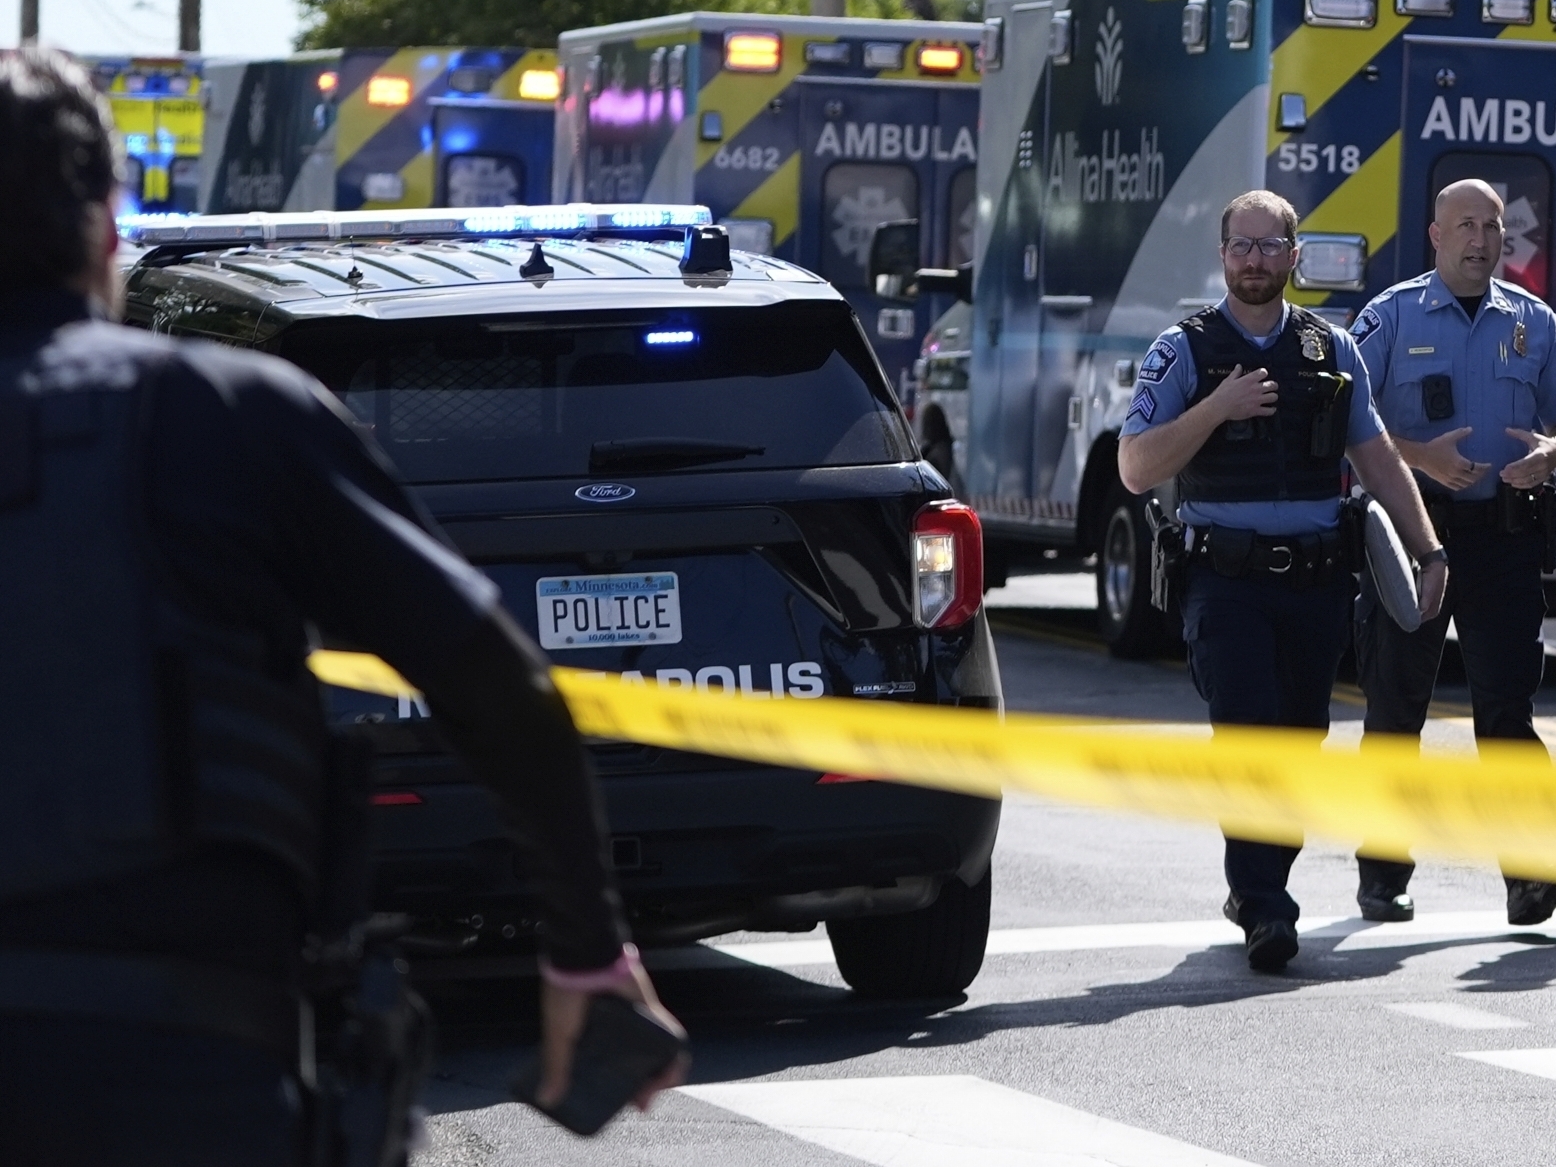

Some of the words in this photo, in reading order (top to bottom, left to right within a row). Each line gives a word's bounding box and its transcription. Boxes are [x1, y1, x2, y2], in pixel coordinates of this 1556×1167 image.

[814, 121, 977, 161] AMBULA
[715, 146, 780, 171] 6682
[1278, 142, 1360, 174] 5518
[589, 485, 622, 497] Ford
[575, 580, 639, 592] Minnesota
[552, 594, 671, 633] POLICE
